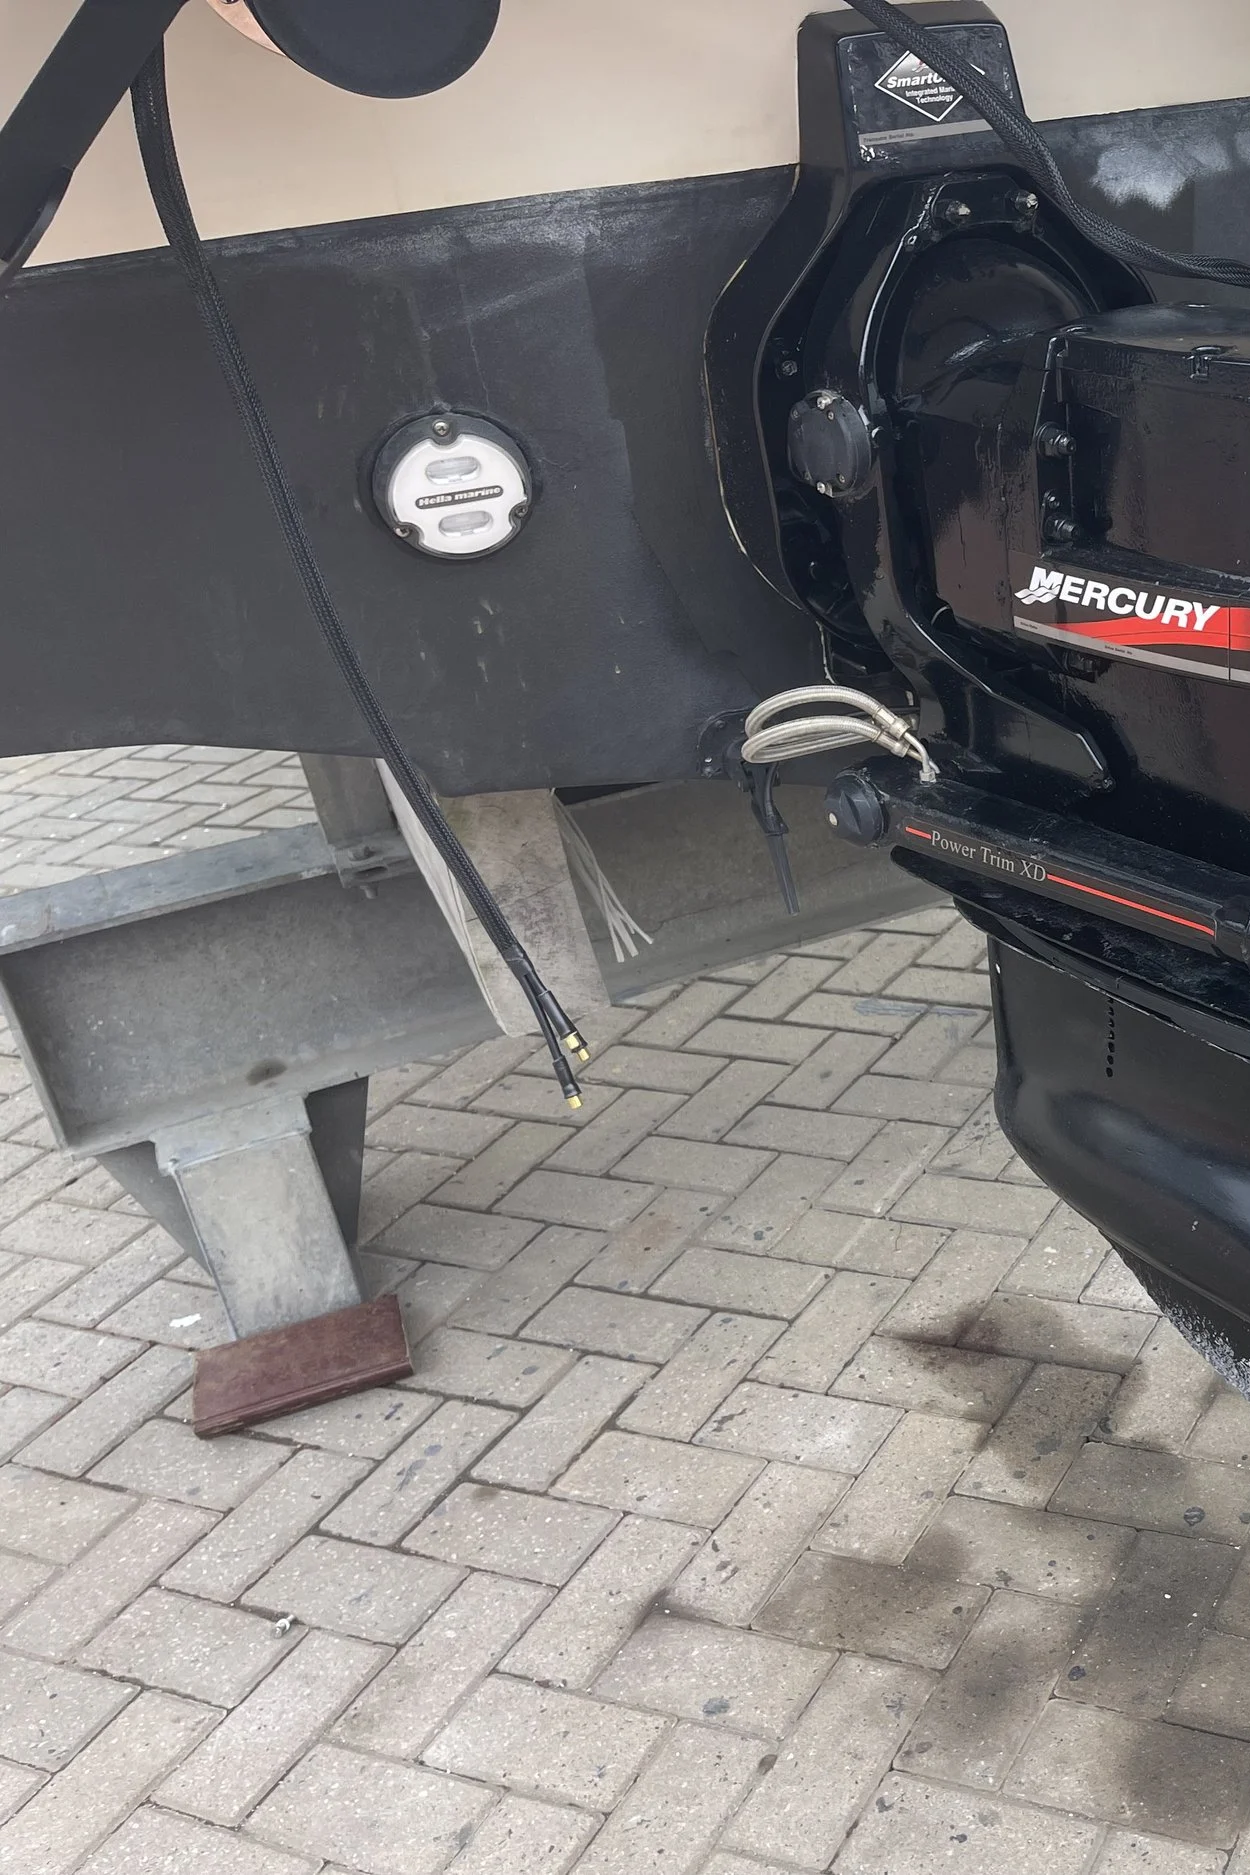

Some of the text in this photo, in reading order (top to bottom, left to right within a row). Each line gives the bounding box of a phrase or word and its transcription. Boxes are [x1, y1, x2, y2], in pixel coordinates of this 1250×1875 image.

[905, 87, 938, 97] Integrated
[916, 94, 954, 104] Technology
[418, 487, 501, 506] Hella marine
[1014, 566, 1221, 631] MERCURY
[931, 830, 1046, 882] Power Trim XD
